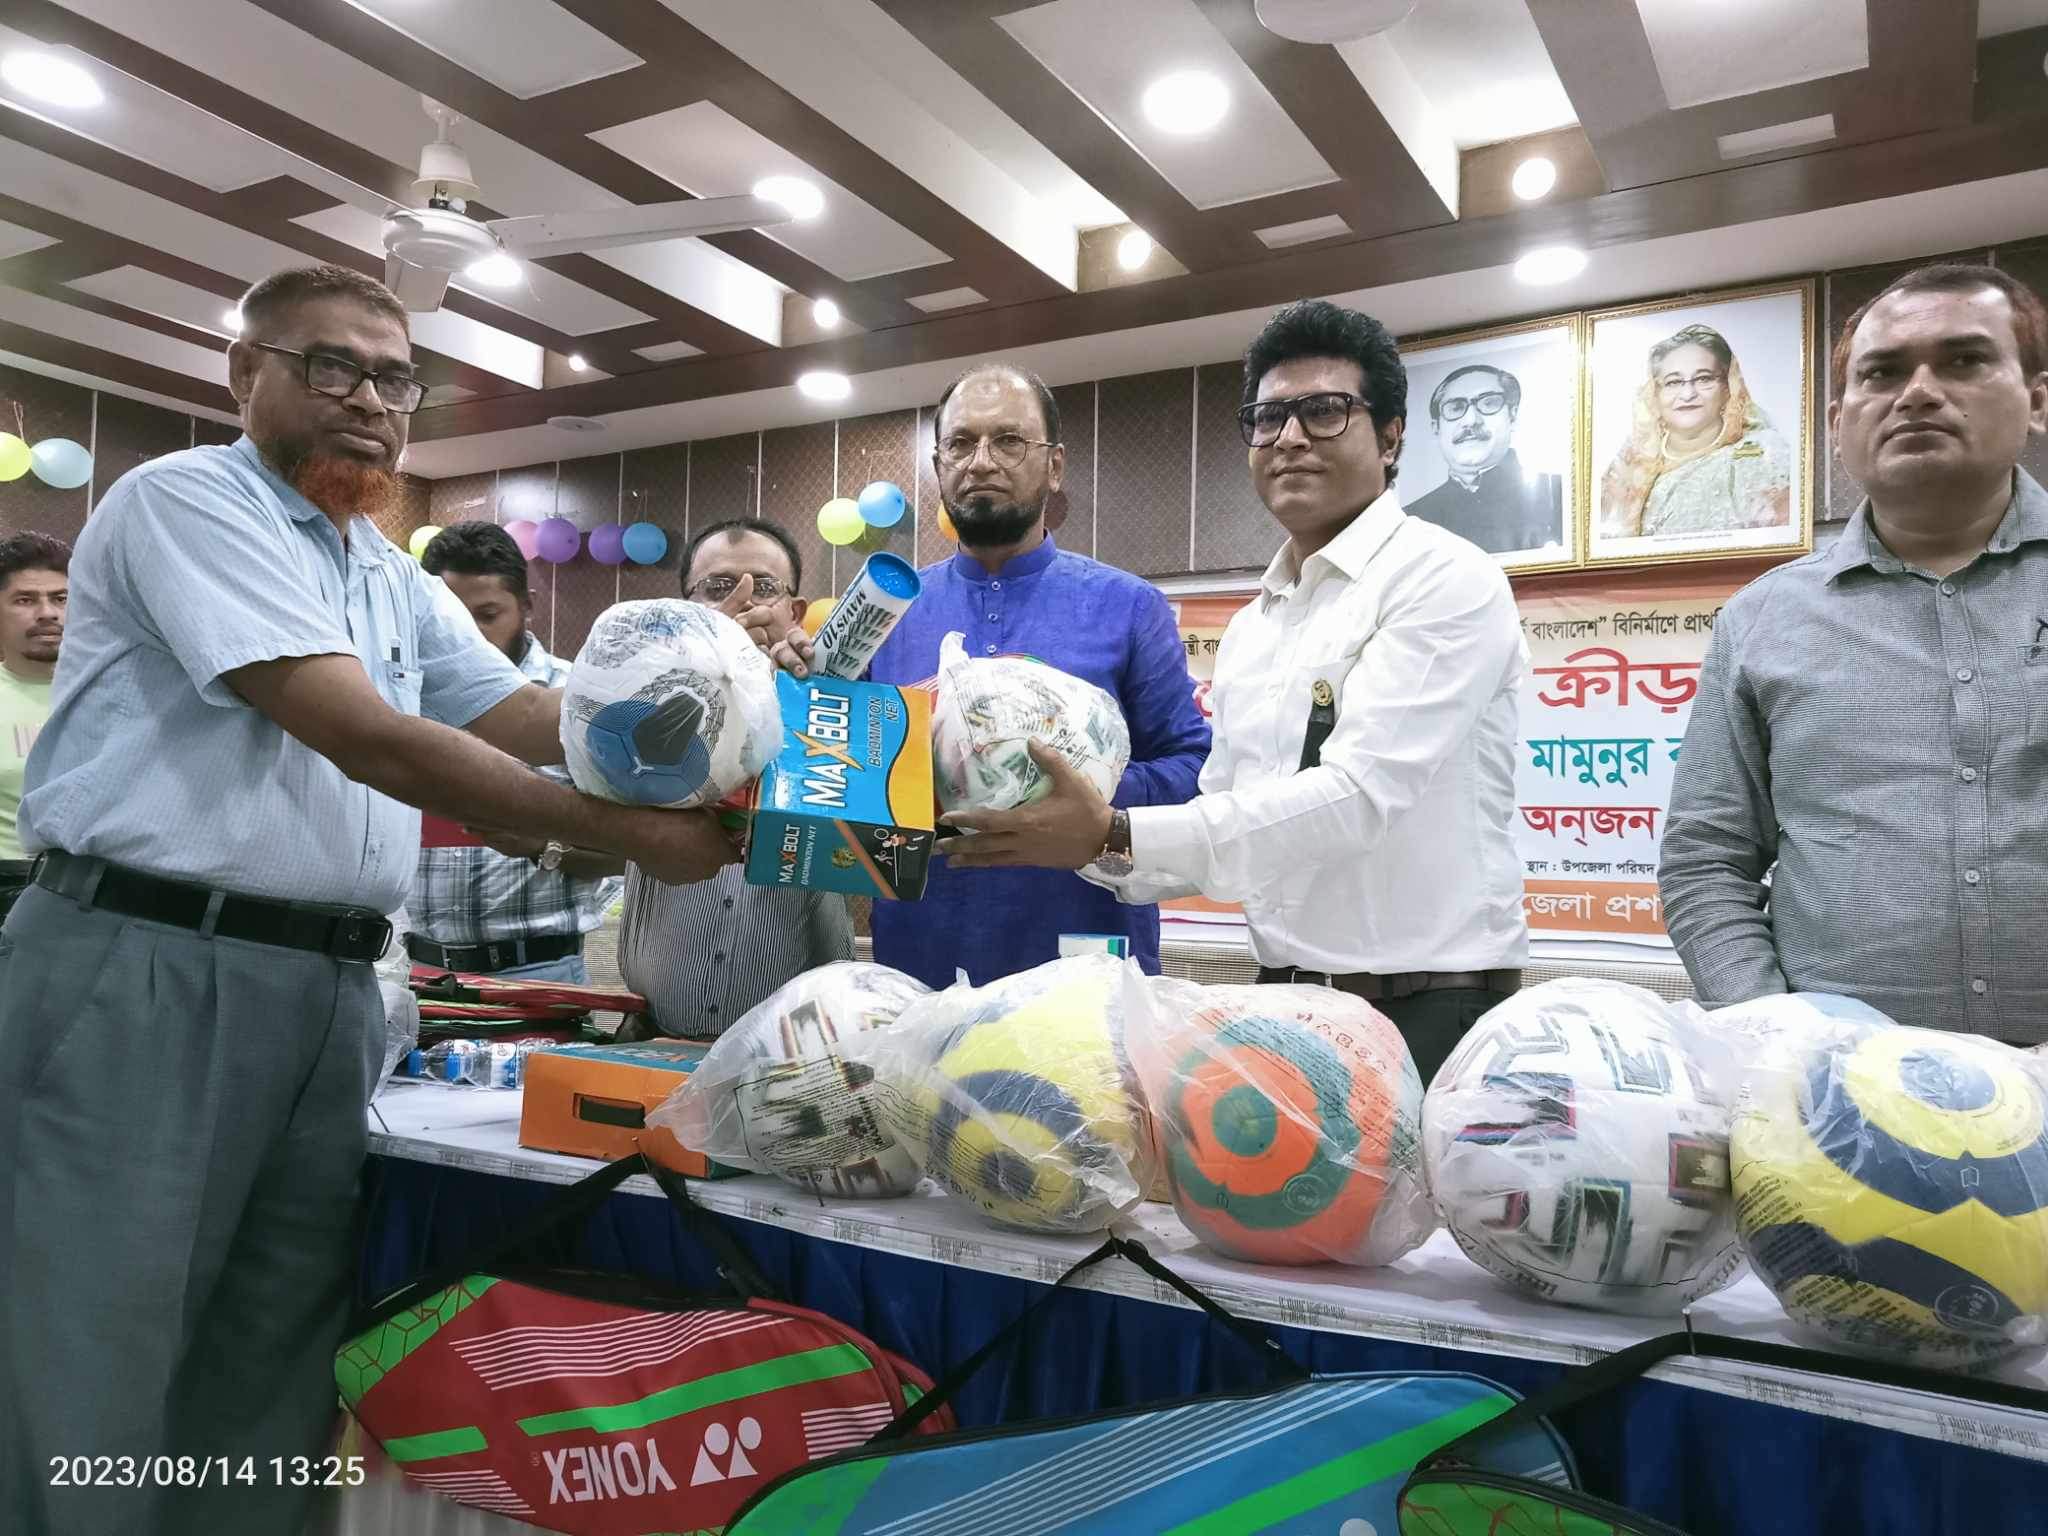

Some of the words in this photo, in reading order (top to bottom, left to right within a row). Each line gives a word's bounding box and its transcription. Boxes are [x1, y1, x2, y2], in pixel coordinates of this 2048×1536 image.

[1613, 609, 1679, 636] বিনির্মাণে
[1533, 648, 1702, 713] ক্রীড়
[867, 697, 881, 767] BADMINTON
[885, 699, 899, 721] NET
[794, 688, 864, 808] MAXBOLT
[1526, 735, 1655, 788] মামুনুর
[777, 823, 800, 884] MAXBOLT
[1561, 859, 1611, 873] উপজেলা
[1616, 860, 1656, 875] পরিষদ
[1523, 891, 1597, 920] জেলা
[1605, 894, 1661, 922] প্রশ
[542, 1438, 677, 1504] YONEX
